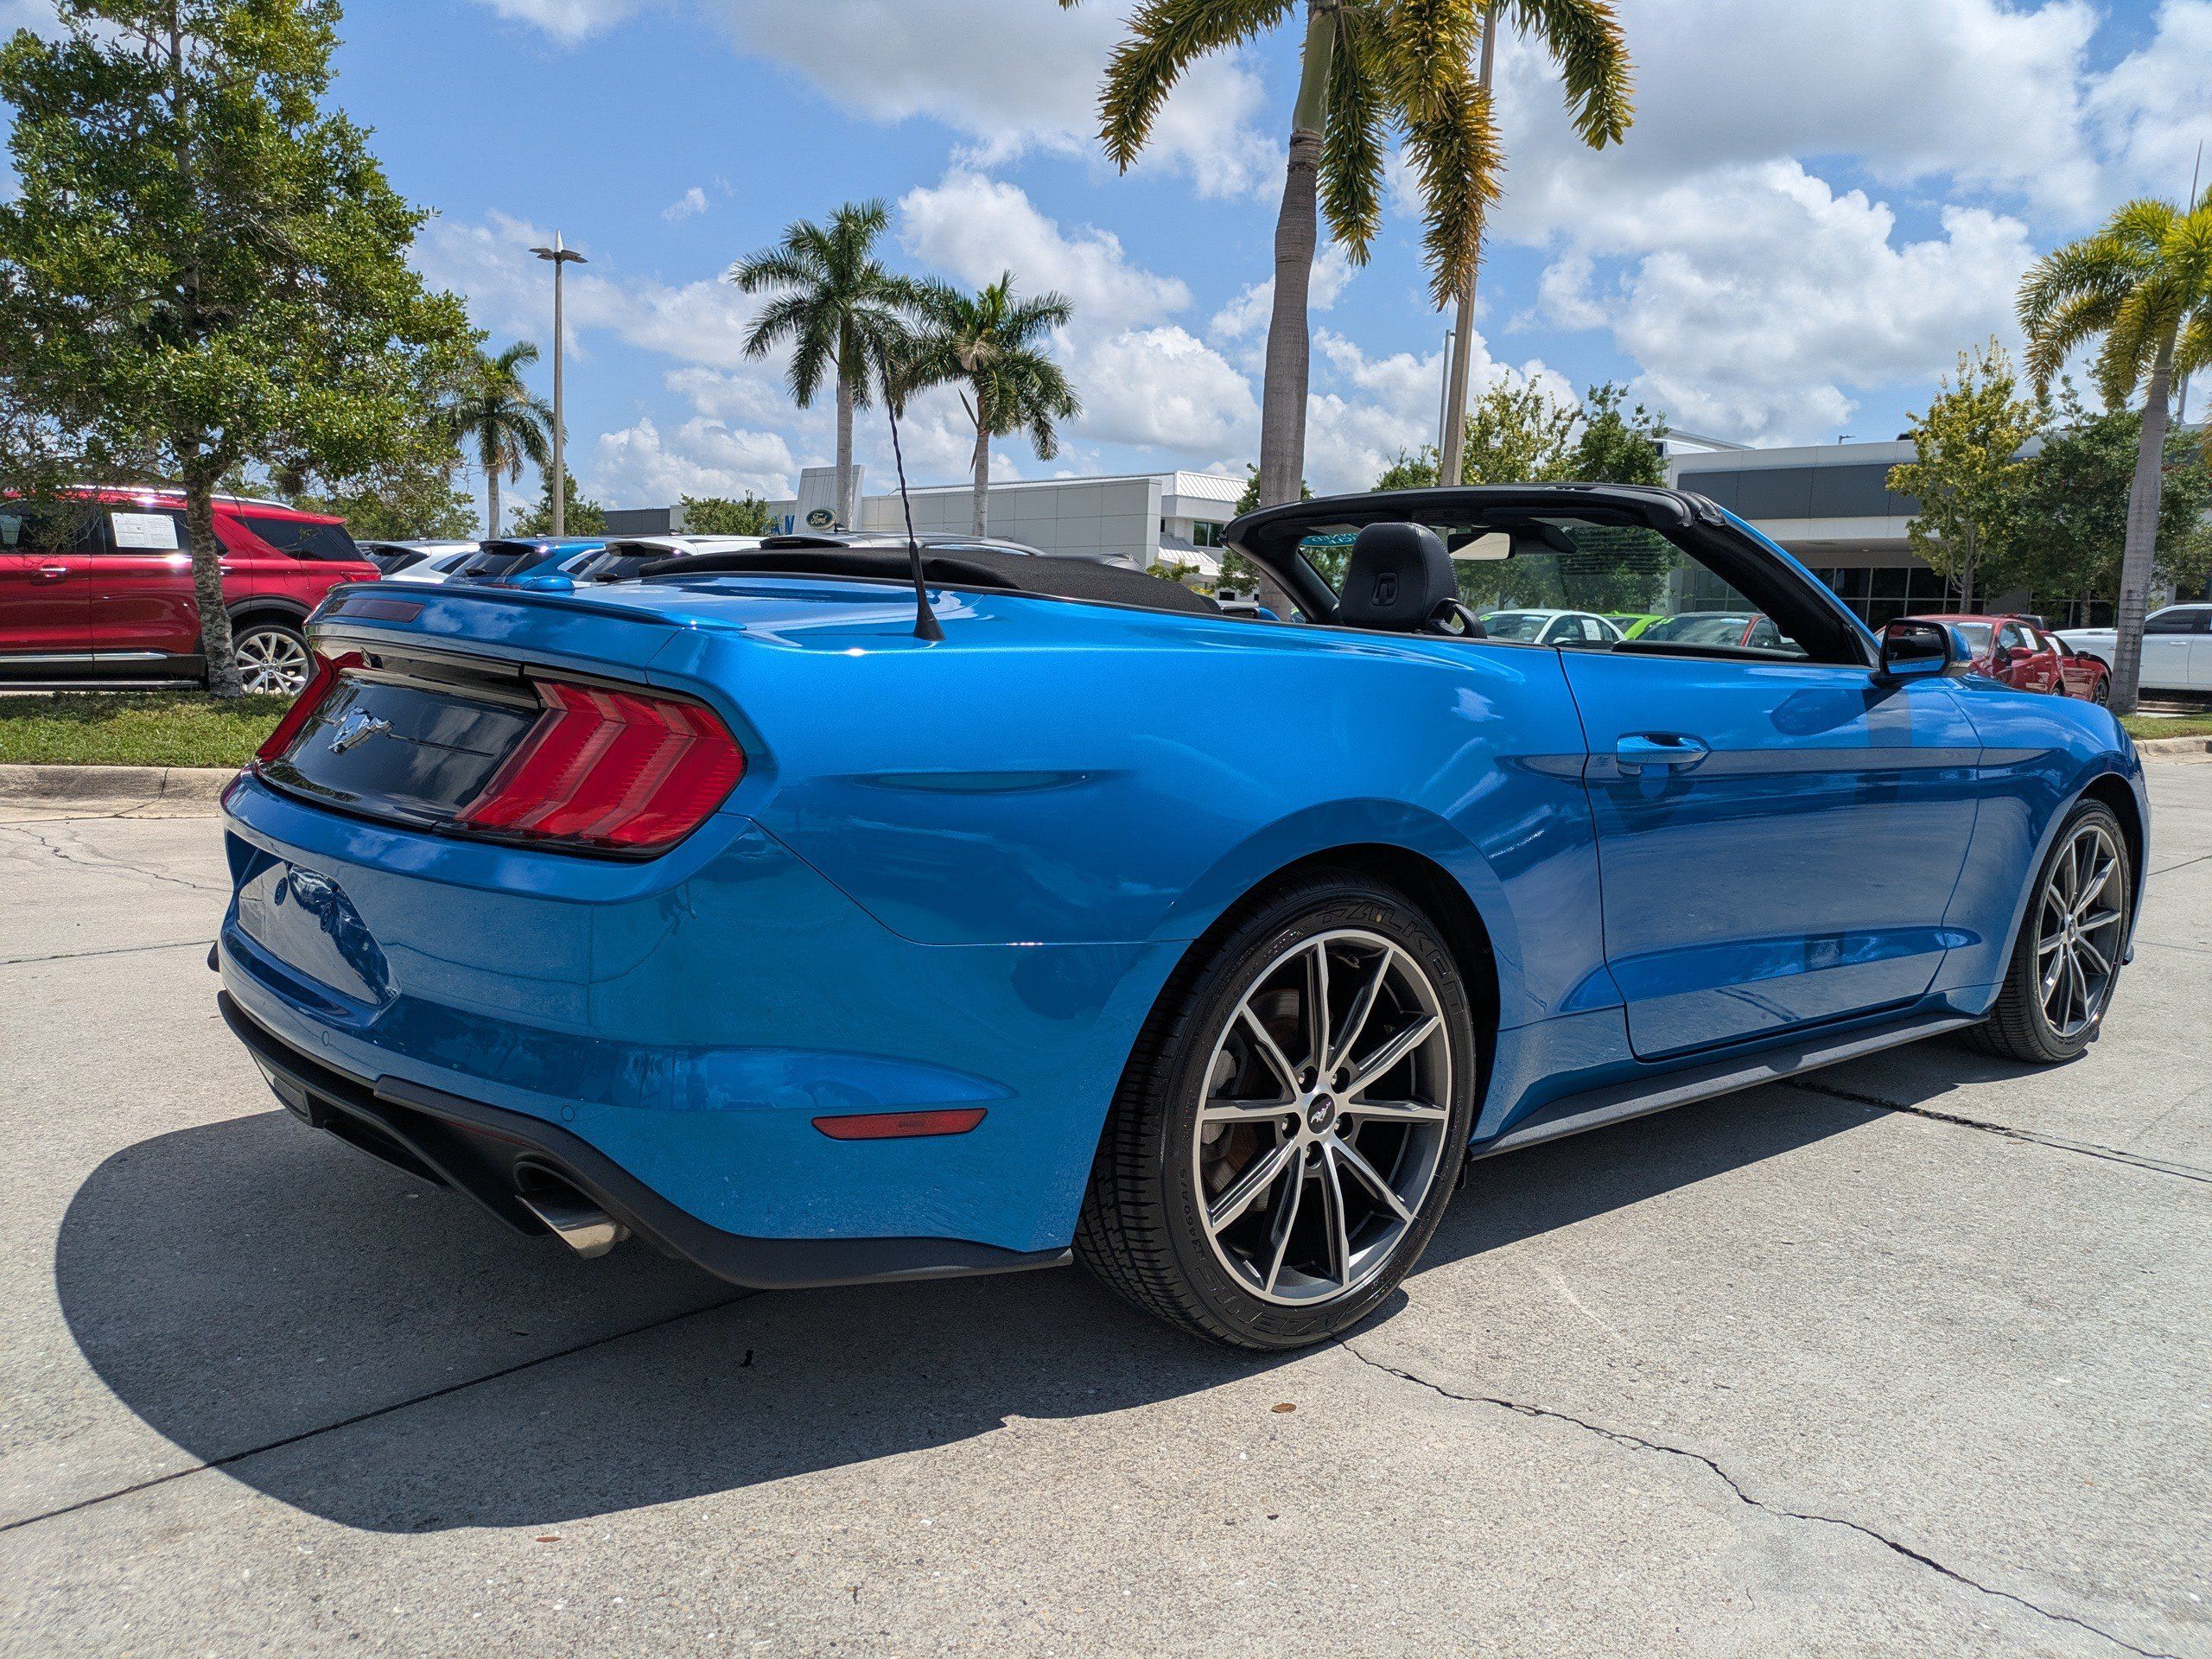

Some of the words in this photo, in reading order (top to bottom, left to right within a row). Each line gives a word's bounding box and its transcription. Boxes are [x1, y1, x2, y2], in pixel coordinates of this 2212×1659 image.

[810, 512, 828, 524] Ford
[1316, 900, 1465, 1016] FALKEN
[1195, 1267, 1354, 1338] AZENIS
